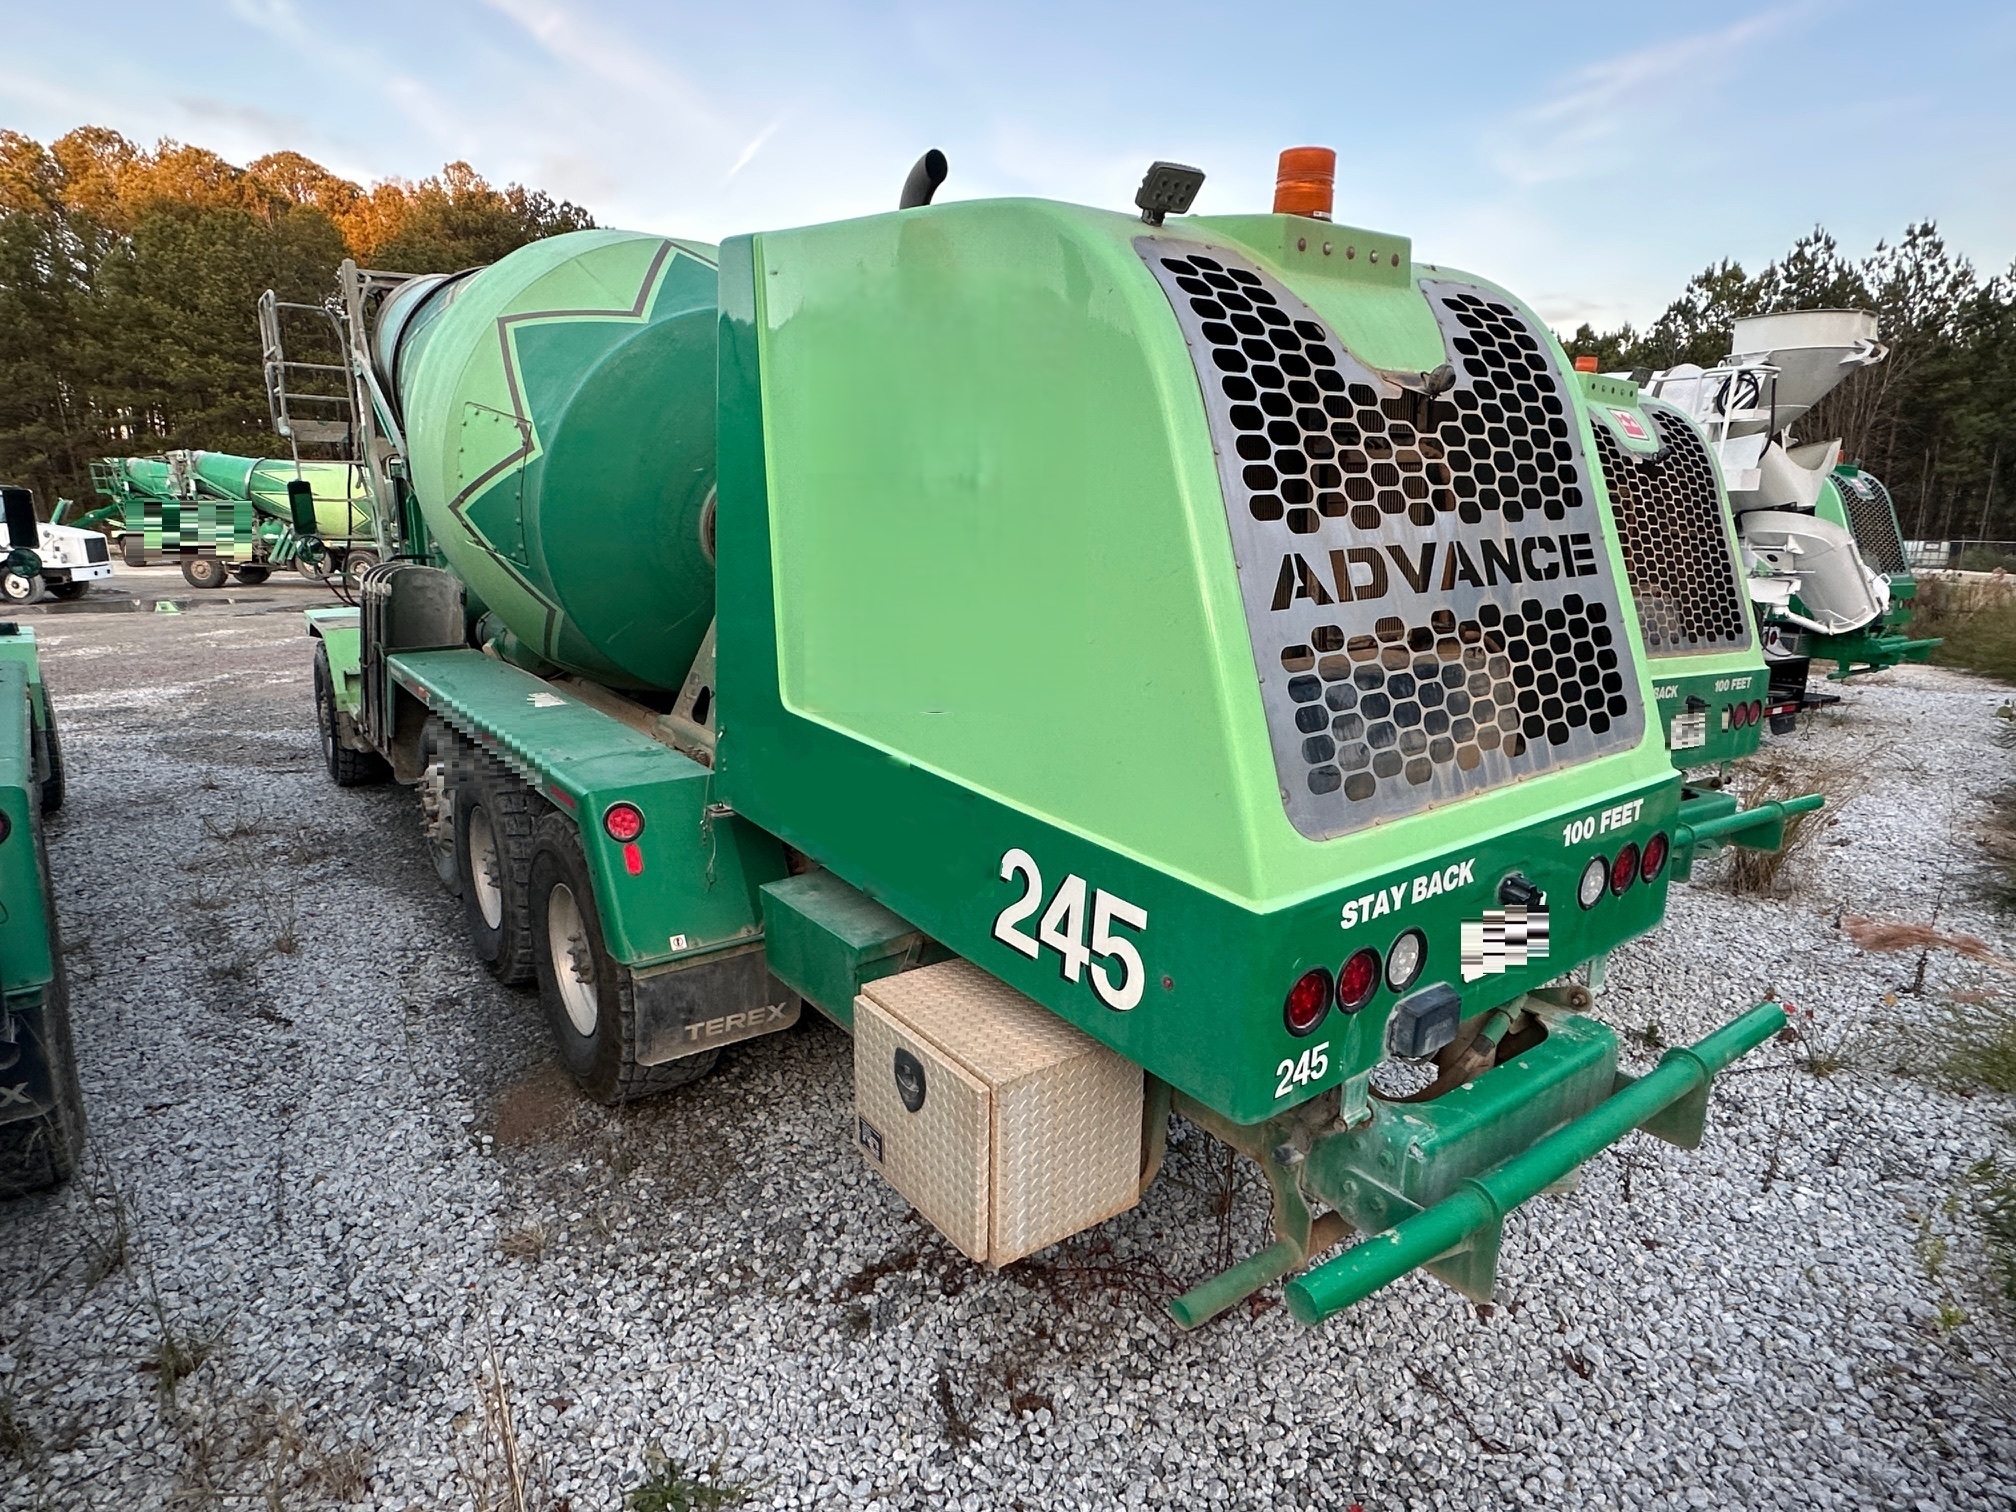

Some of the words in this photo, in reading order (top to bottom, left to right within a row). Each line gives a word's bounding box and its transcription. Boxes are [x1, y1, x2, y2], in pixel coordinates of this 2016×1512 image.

[1270, 532, 1598, 612] ADVANCE
[1714, 678, 1729, 693] 100
[1731, 676, 1752, 690] FEET
[1340, 881, 1408, 930] STAY
[1410, 857, 1476, 905] BACK
[1562, 815, 1595, 847] 100
[1599, 798, 1644, 834] FEET
[991, 847, 1148, 1012] 245
[684, 1001, 787, 1041] TEREX
[1273, 1041, 1330, 1101] 245
